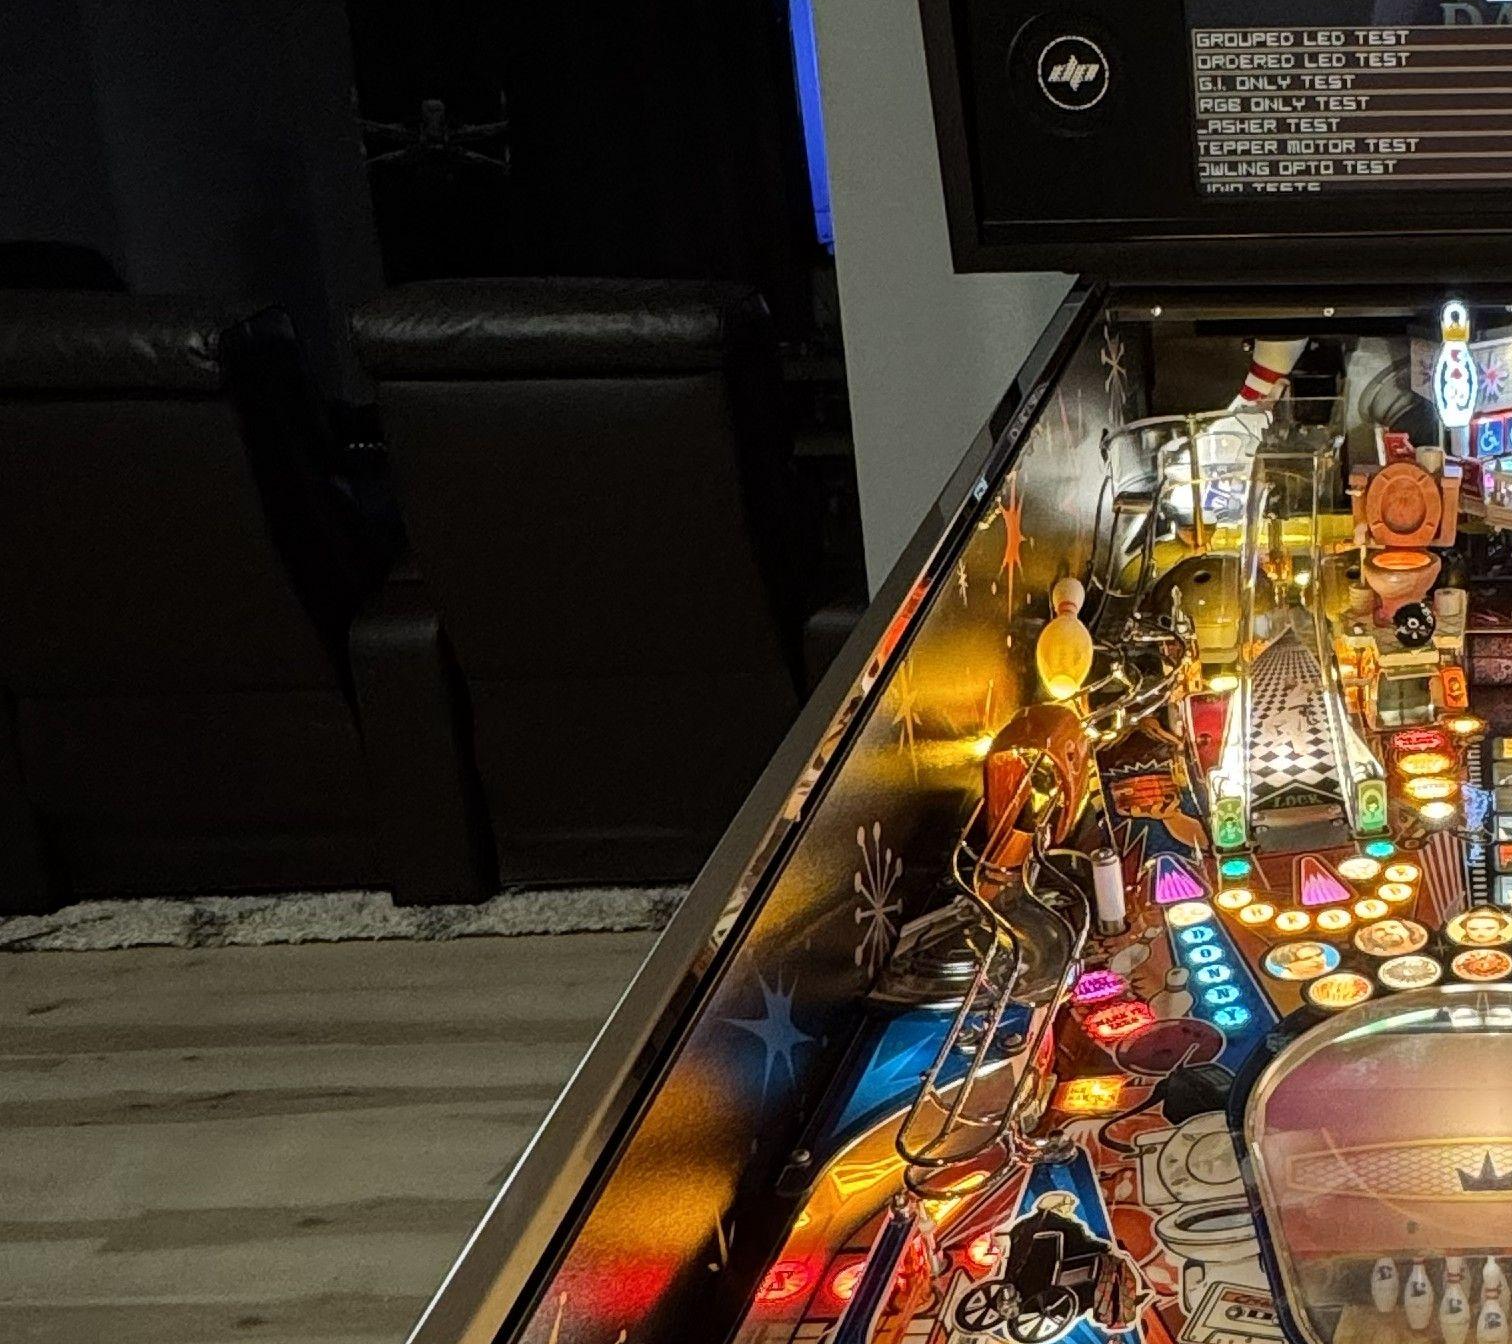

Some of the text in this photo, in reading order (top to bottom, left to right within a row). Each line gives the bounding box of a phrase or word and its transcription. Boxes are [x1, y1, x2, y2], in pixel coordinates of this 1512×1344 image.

[1196, 30, 1410, 48] GROUPED LED TEST
[1198, 52, 1411, 70] ORDERED LED TEST
[1199, 75, 1356, 91] G.I. ONLY TEST
[1200, 96, 1370, 112] RGB ONLY TEST
[1287, 118, 1340, 133] TEST
[1198, 139, 1419, 156] TEPPER MOTOR TEST
[1198, 160, 1398, 176] OWLING OPTO TEST
